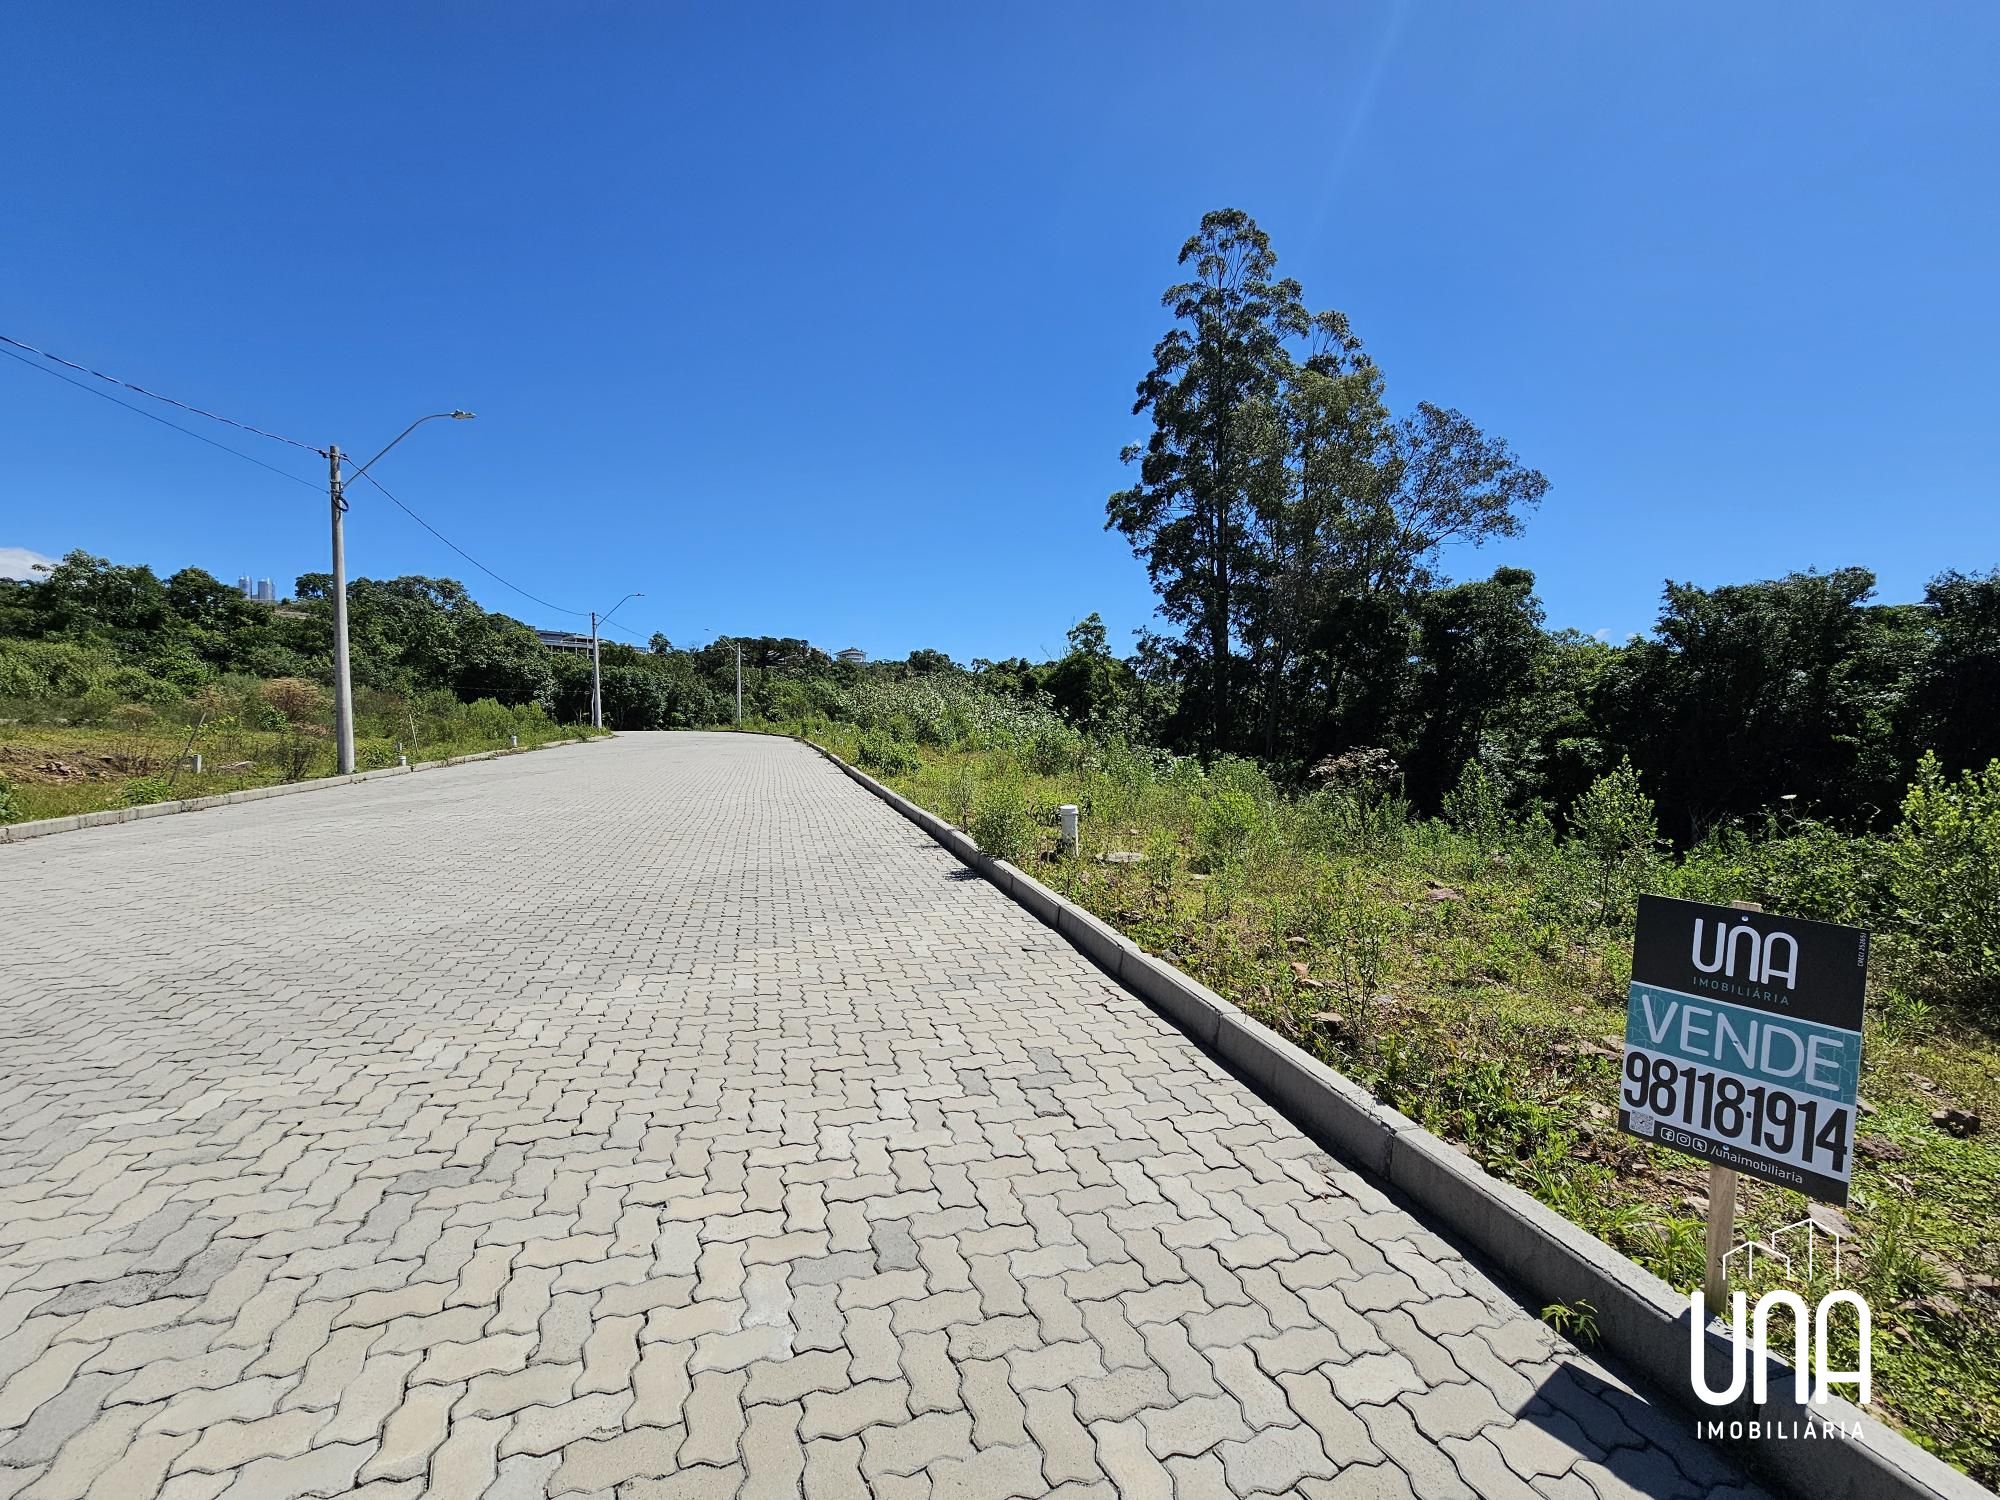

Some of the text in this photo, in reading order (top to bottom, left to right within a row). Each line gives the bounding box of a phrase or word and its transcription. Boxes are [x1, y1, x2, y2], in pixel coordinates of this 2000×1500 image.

[1692, 918, 1799, 990] UNA
[1693, 976, 1790, 1006] IMOBILIÁRIA
[1642, 994, 1844, 1092] VENDE
